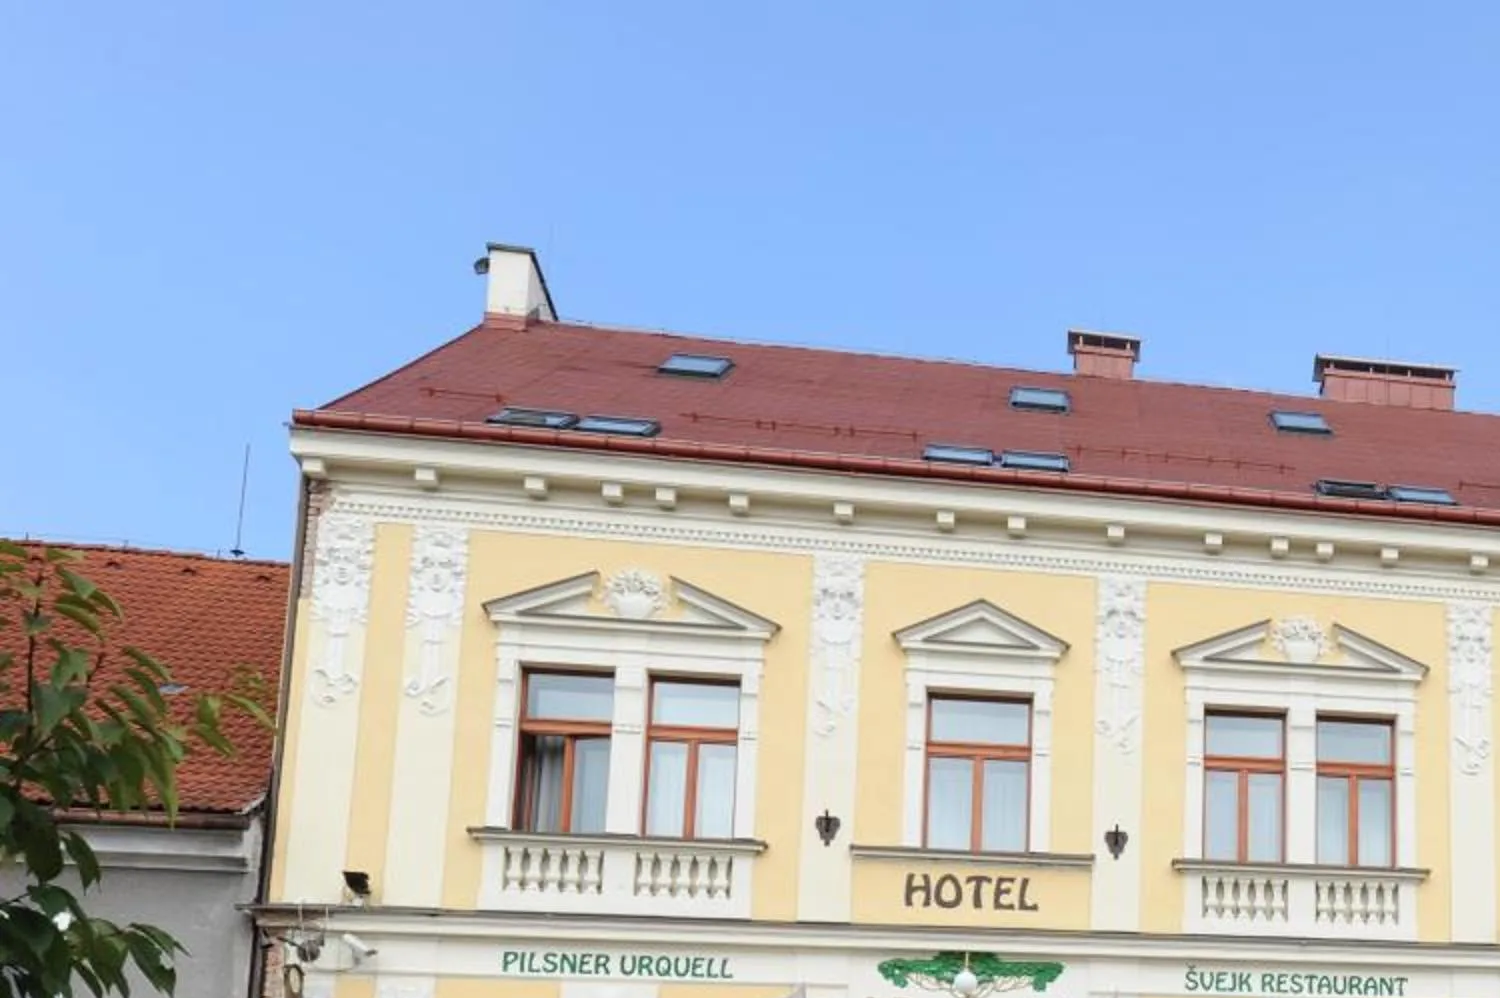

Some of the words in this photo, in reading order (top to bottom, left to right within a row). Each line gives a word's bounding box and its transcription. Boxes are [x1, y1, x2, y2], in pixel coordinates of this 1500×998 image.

[904, 873, 1039, 911] HOTEL
[502, 951, 611, 975] PILSNER
[619, 955, 734, 979] URQUELL
[1184, 965, 1251, 992] ŠVEJK
[1261, 973, 1409, 997] RESTAURANT
